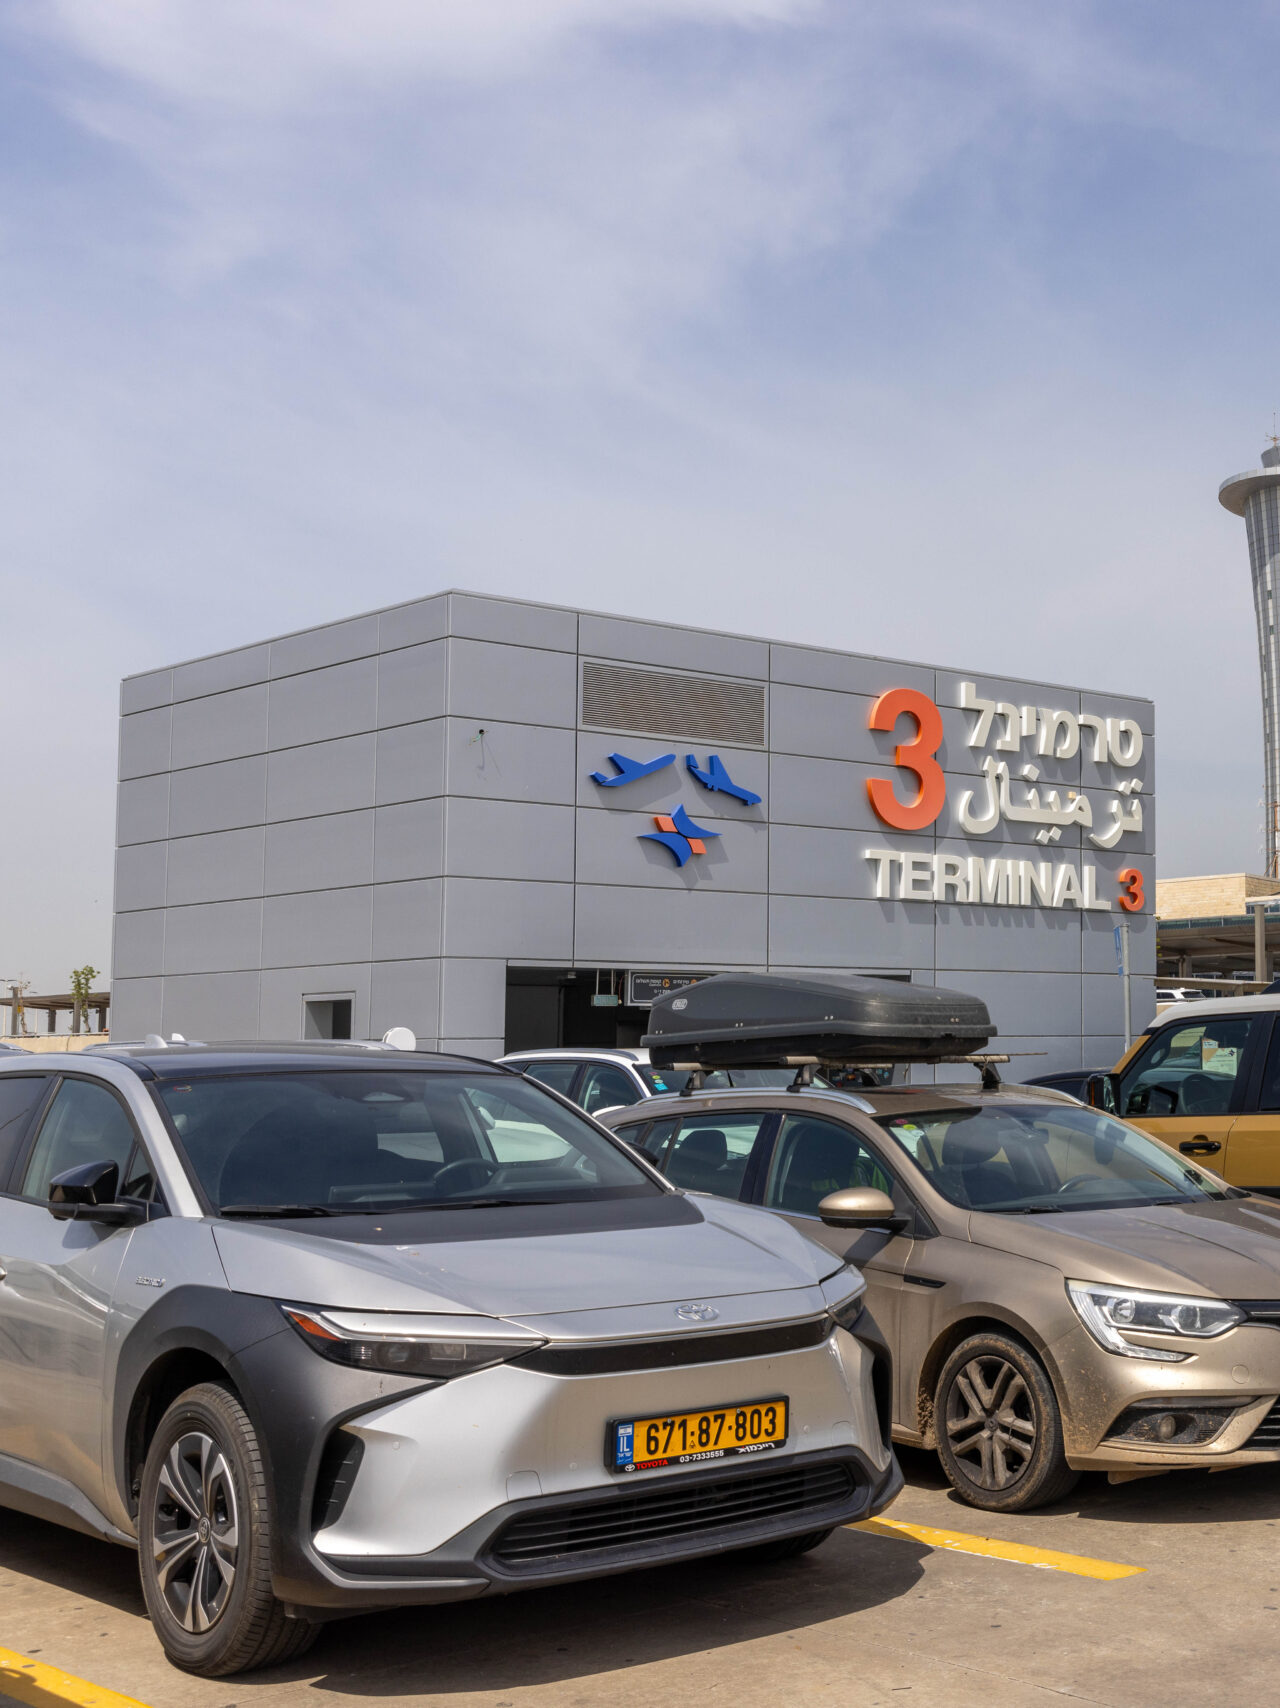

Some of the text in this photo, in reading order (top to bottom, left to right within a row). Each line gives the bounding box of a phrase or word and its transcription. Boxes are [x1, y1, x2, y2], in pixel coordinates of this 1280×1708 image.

[867, 688, 946, 830] 3
[960, 682, 1143, 767] טרמינל
[959, 755, 1143, 848] ترمينال
[864, 849, 1144, 911] TERMINAL 3
[619, 1436, 630, 1453] IL
[636, 1458, 669, 1471] TOYOTA
